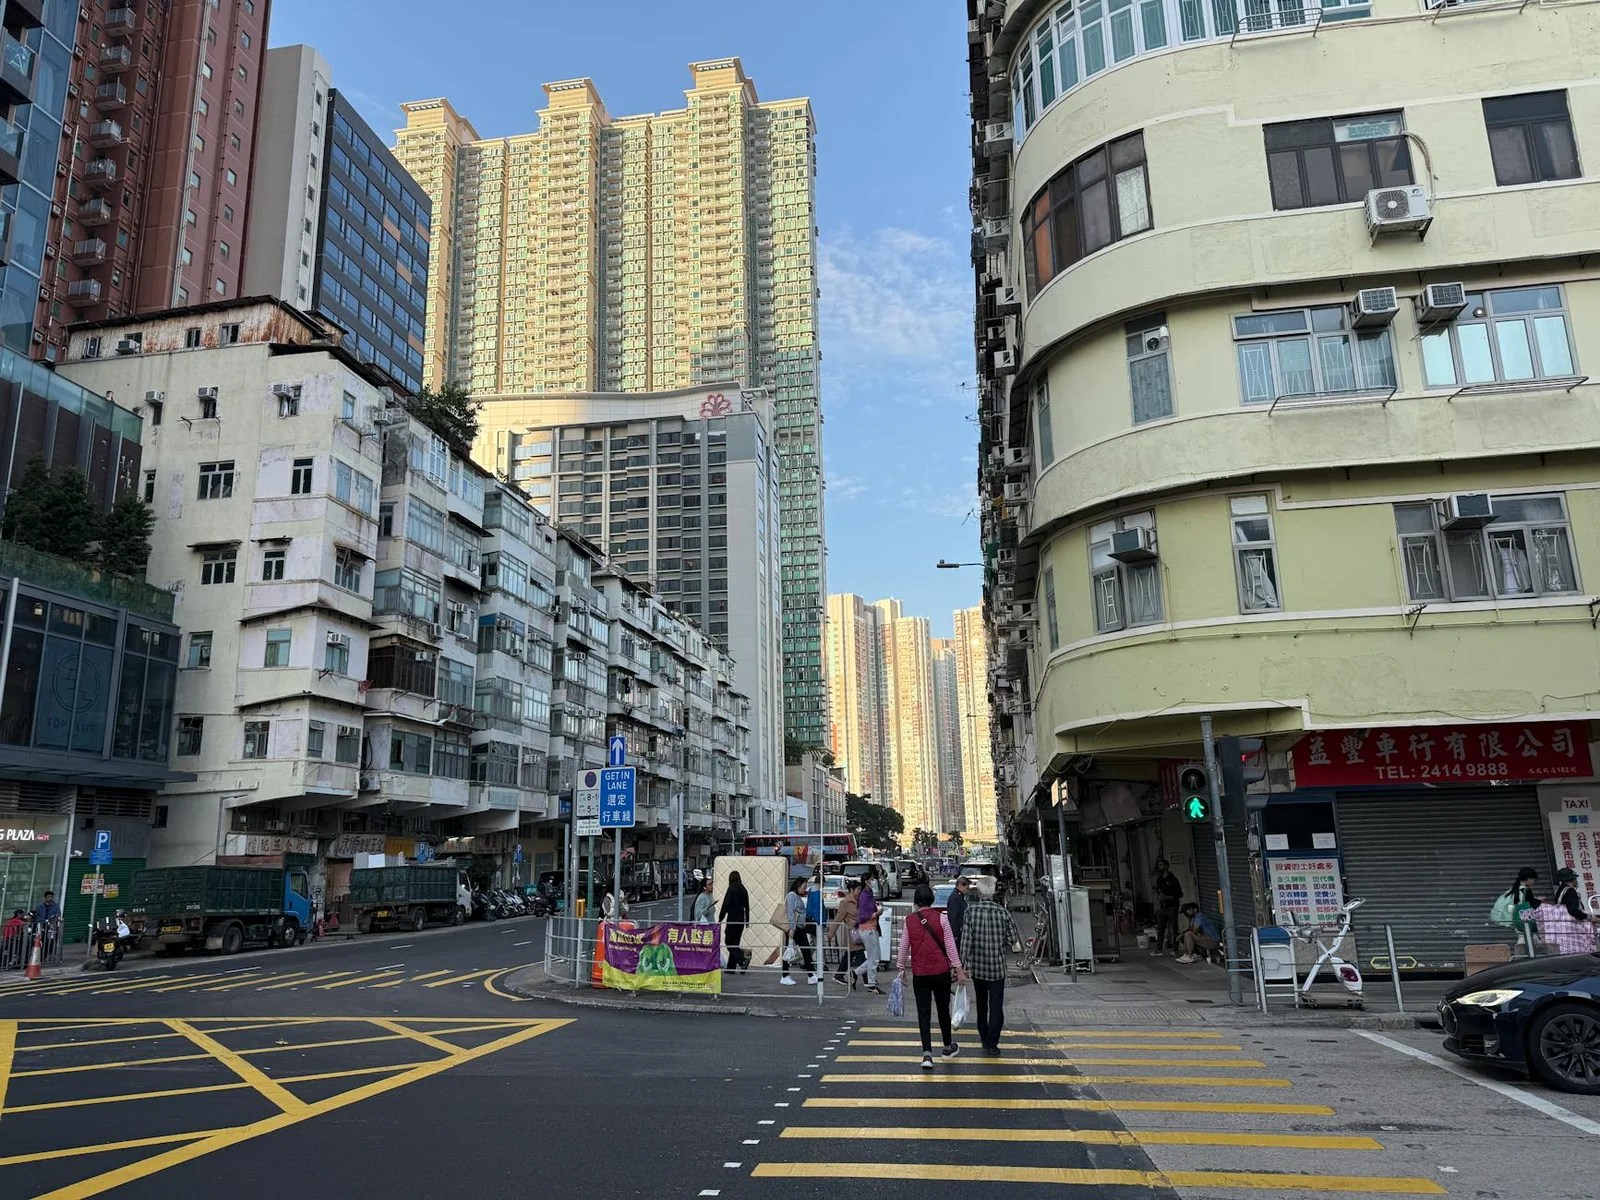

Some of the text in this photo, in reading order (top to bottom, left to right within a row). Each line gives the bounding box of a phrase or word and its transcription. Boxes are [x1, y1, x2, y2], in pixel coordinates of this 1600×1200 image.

[1308, 728, 1575, 765] 益豐車行有限公司
[605, 771, 630, 780] GET IN
[1375, 762, 1508, 779] TEL: 2414 9888
[607, 781, 627, 790] LANE
[607, 794, 627, 806] 選定
[1563, 799, 1589, 809] TAXI
[6, 829, 35, 841] PLAZA
[97, 832, 108, 849] P
[1275, 862, 1334, 872] 投資的士好處多
